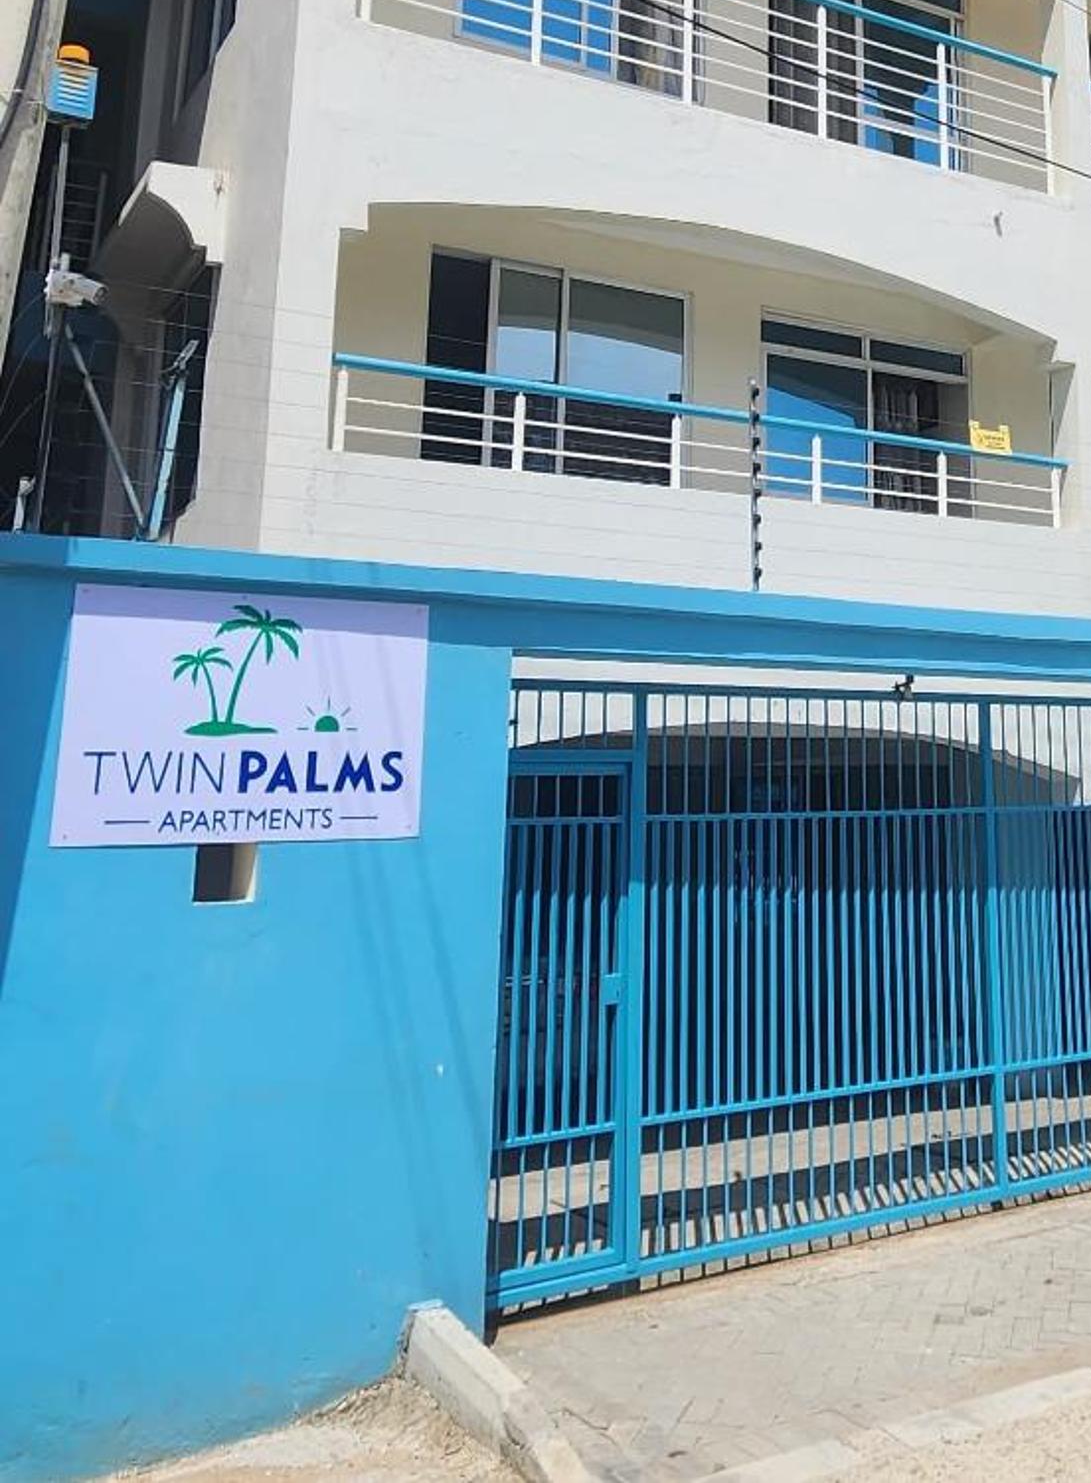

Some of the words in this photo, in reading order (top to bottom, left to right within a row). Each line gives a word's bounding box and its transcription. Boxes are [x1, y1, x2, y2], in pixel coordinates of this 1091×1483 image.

[84, 751, 226, 794] TWIN
[239, 750, 404, 794] PALMS
[158, 809, 333, 832] APARTMENTS
